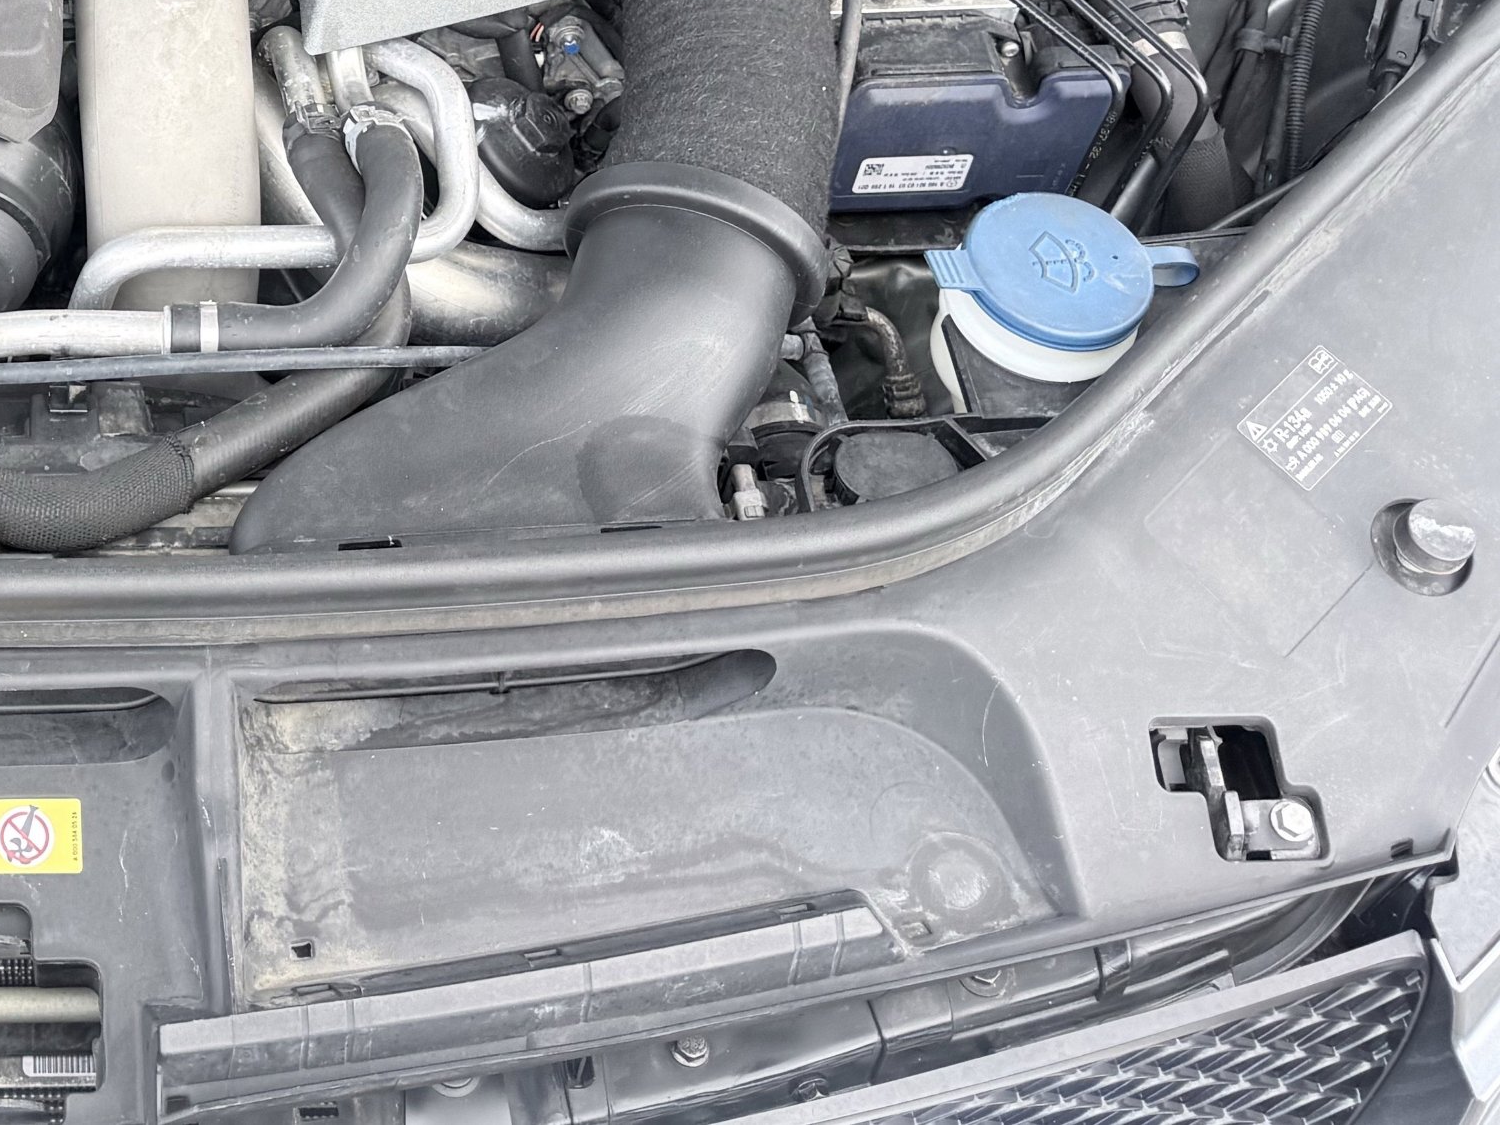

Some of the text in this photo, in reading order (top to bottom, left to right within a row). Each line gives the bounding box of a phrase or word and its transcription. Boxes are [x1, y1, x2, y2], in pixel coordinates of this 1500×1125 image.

[1273, 407, 1312, 442] R-134a
[1296, 450, 1307, 460] A
[1302, 436, 1319, 453] 000
